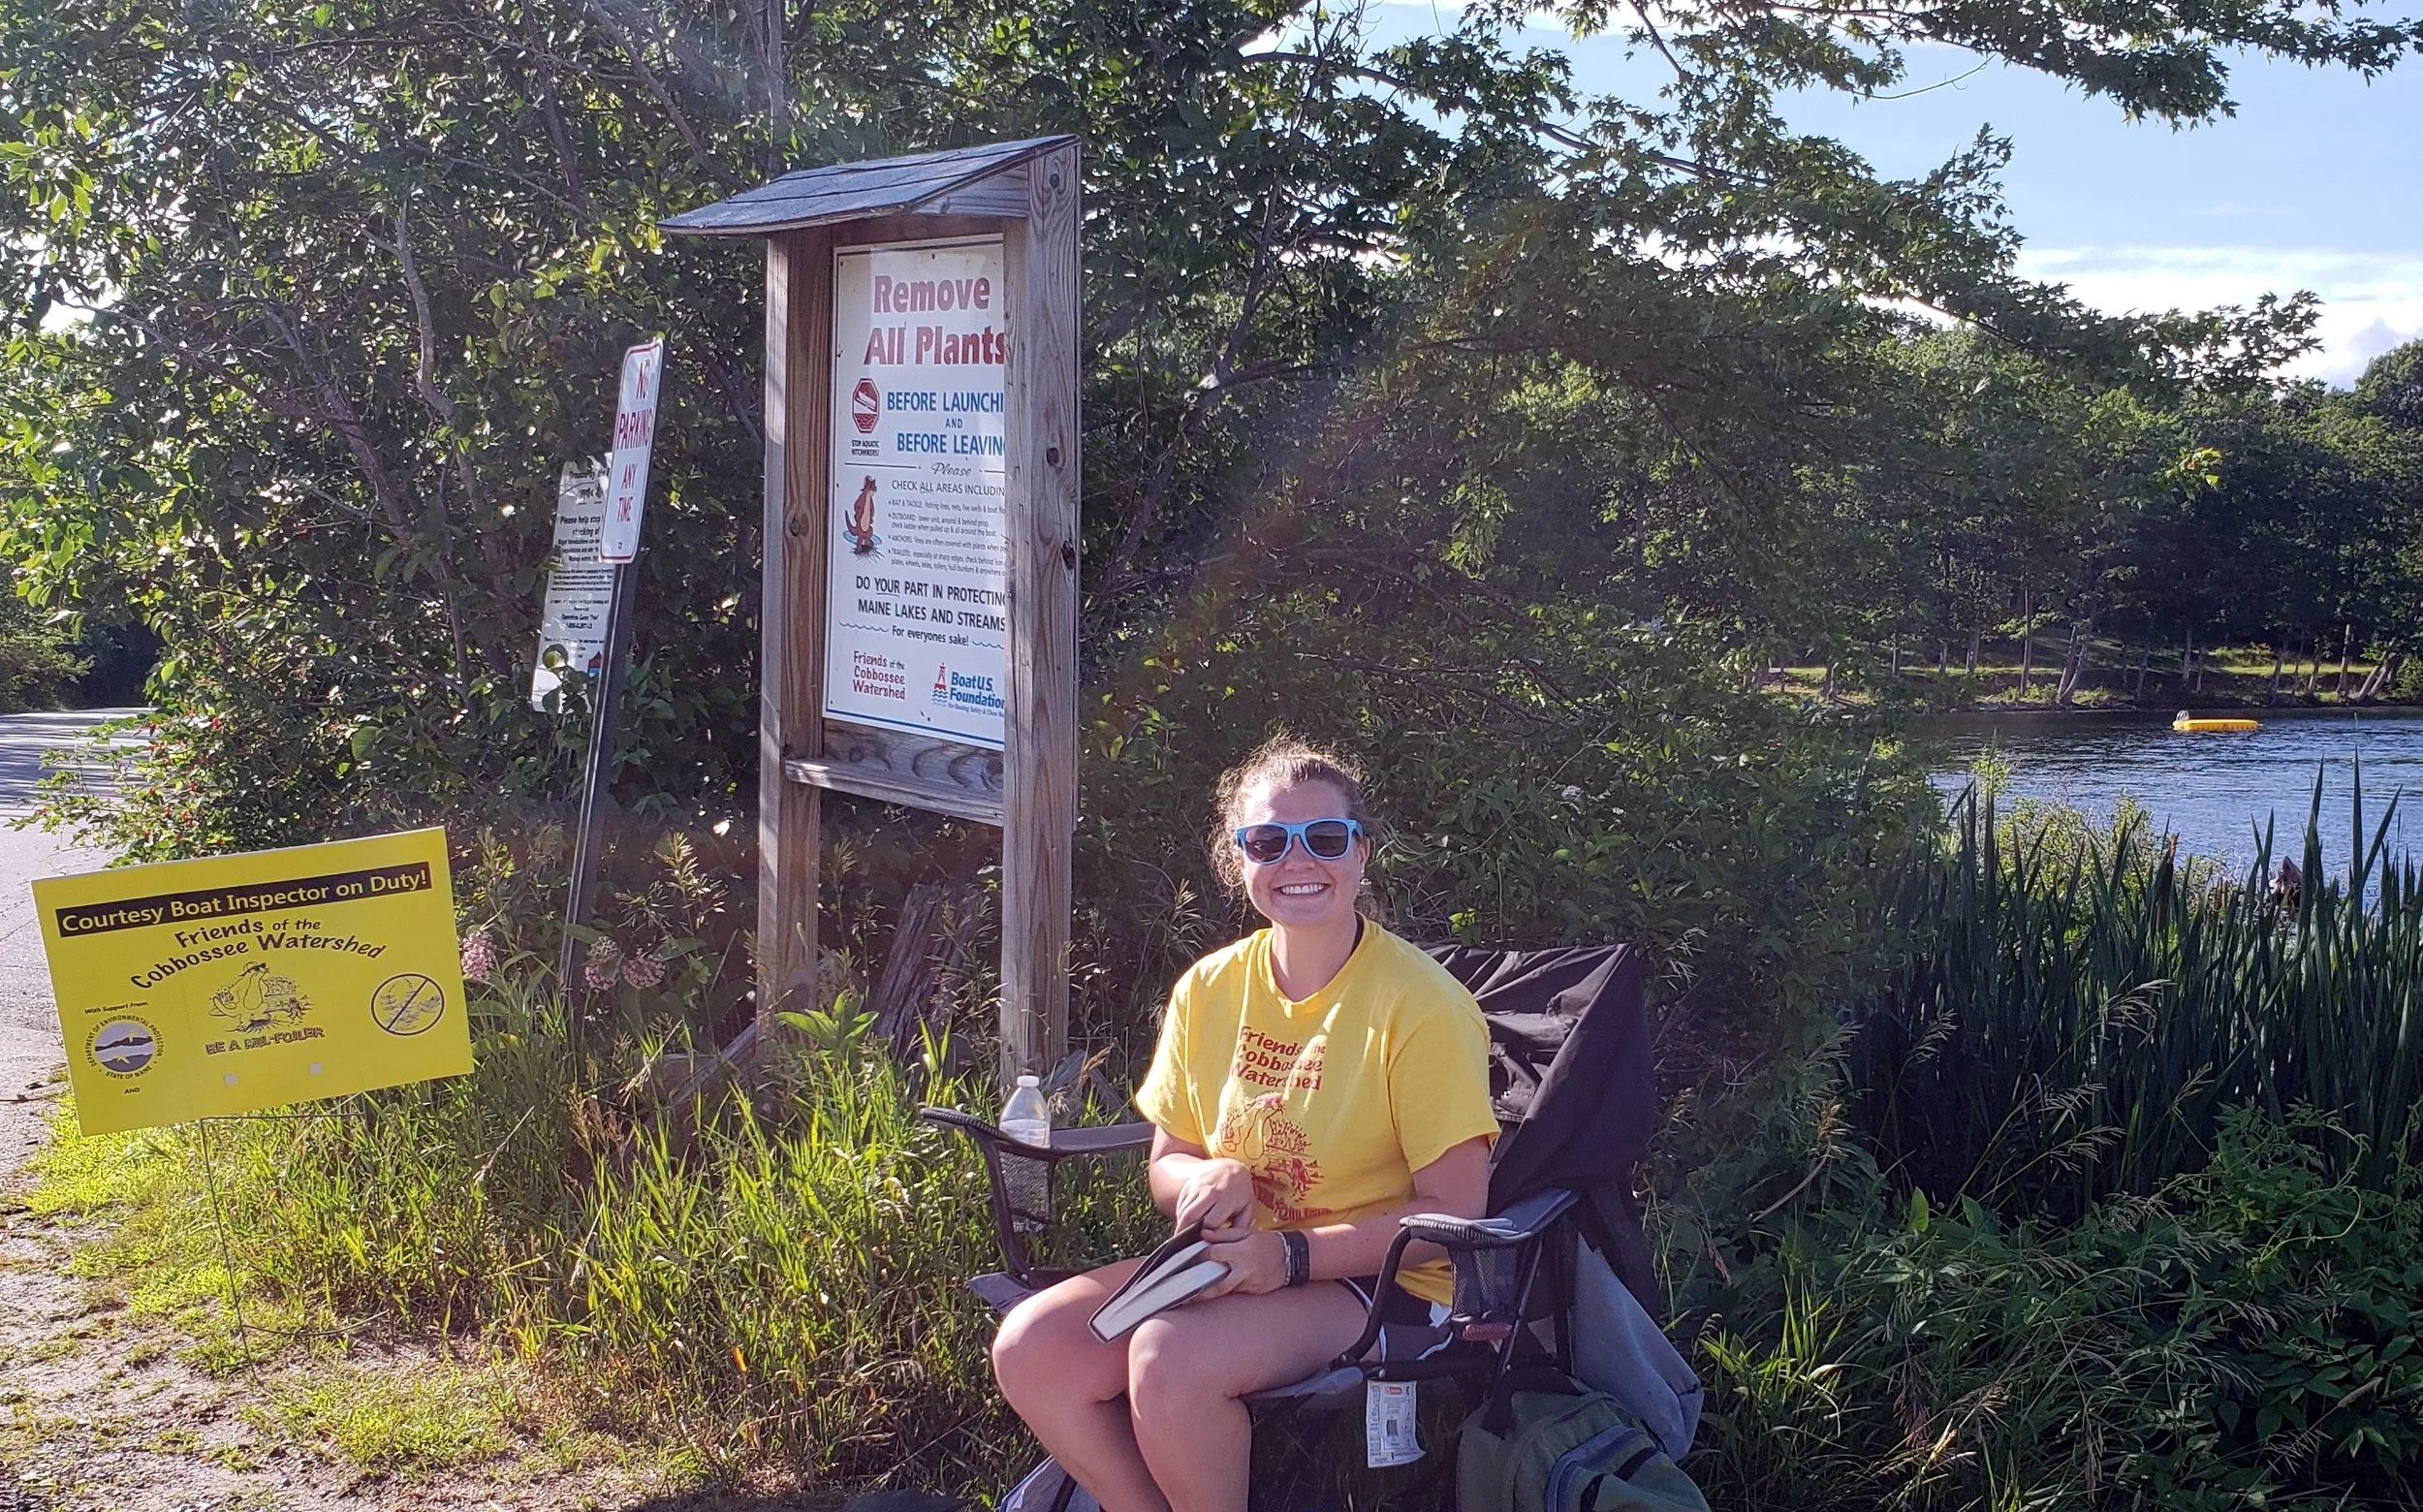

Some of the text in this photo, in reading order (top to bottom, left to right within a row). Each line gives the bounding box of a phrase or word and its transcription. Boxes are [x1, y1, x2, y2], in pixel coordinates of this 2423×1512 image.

[873, 275, 991, 313] Remove
[864, 326, 1005, 364] All Plants
[636, 359, 650, 400] NO
[887, 392, 936, 412] BEFORE
[616, 407, 655, 451] PARKING
[945, 418, 962, 428] AND
[897, 433, 1005, 457] BEFORE LEAVIN
[621, 463, 638, 489] ANY
[931, 462, 971, 477] Please
[892, 480, 917, 490] CHECK
[920, 482, 934, 492] ALL
[936, 483, 962, 494] AREAS
[617, 496, 634, 523] TIME
[856, 575, 870, 589] DO
[874, 577, 900, 594] YOUR
[904, 581, 928, 597] PART
[932, 583, 943, 599] IN
[858, 599, 1005, 632] MAINE LAKES AND STREAMS
[892, 625, 969, 646] For everyones sake!
[853, 651, 887, 667] Friends
[854, 666, 905, 685] Cobbossee
[853, 678, 906, 700] Watershed
[62, 869, 428, 931] Courtesy Boat Inspector on Duty!
[174, 918, 322, 949] Friends of the
[130, 931, 387, 989] Cobbossee Watershed
[100, 1014, 148, 1027] ENVIRONMENTAL
[205, 1041, 226, 1055] BE
[229, 1039, 241, 1051] A
[1240, 1025, 1303, 1055] Friends
[1237, 1043, 1323, 1072] Cobbossee
[106, 1070, 123, 1080] STATE
[135, 1065, 152, 1078] MAINE
[1233, 1060, 1323, 1090] Watershed
